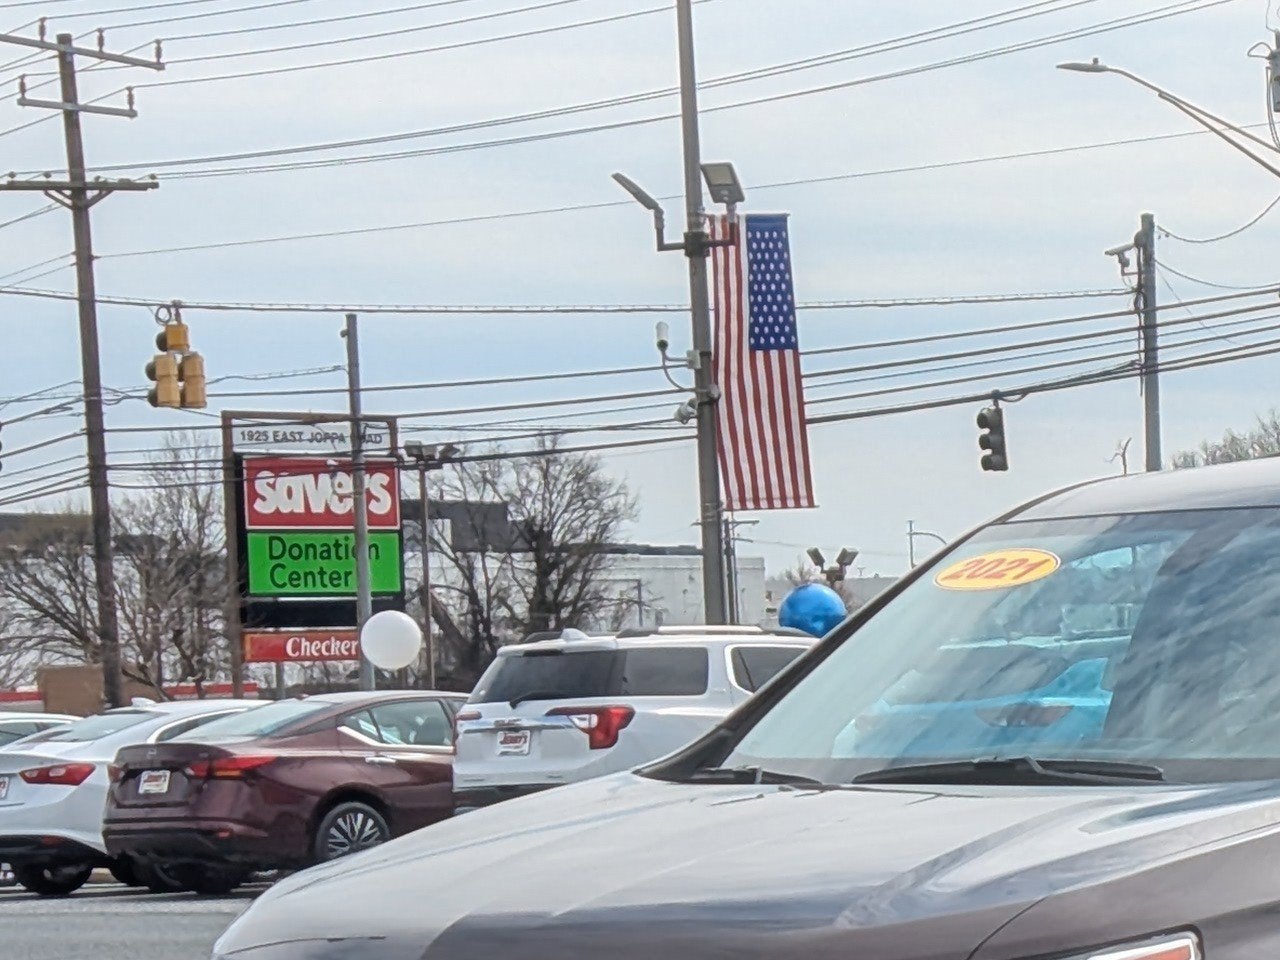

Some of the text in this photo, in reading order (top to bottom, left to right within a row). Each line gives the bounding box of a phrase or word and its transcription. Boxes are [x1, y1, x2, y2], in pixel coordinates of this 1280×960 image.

[240, 430, 269, 442] 1925
[272, 430, 302, 443] EAST
[306, 431, 346, 444] JOPPA
[268, 535, 380, 561] Donatin
[269, 562, 353, 589] Center
[940, 557, 1051, 582] 2021
